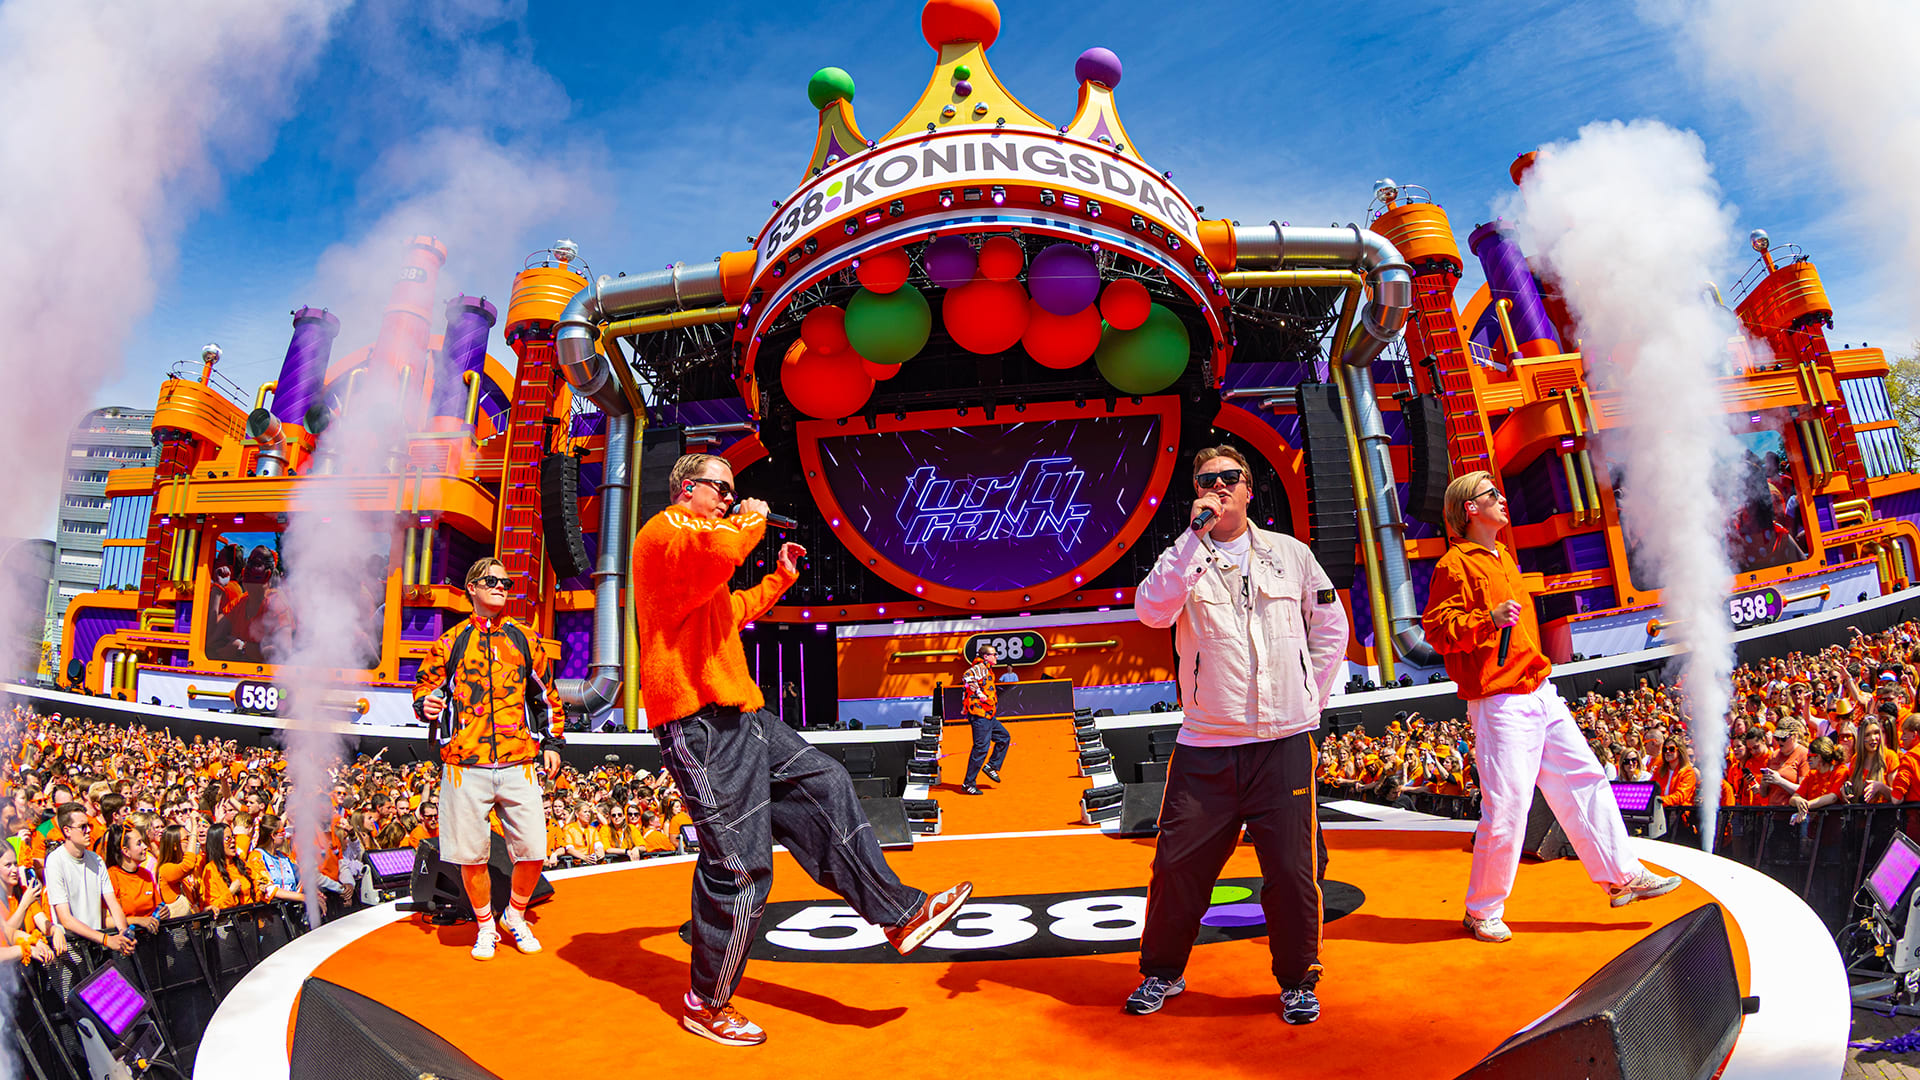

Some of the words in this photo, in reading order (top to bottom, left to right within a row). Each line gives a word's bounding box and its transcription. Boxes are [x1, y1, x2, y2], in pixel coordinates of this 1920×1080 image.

[766, 192, 824, 260] 538
[844, 142, 1192, 237] KONINGSDAG
[1729, 594, 1768, 624] 538
[241, 684, 279, 711] 538
[765, 895, 1149, 951] 538
